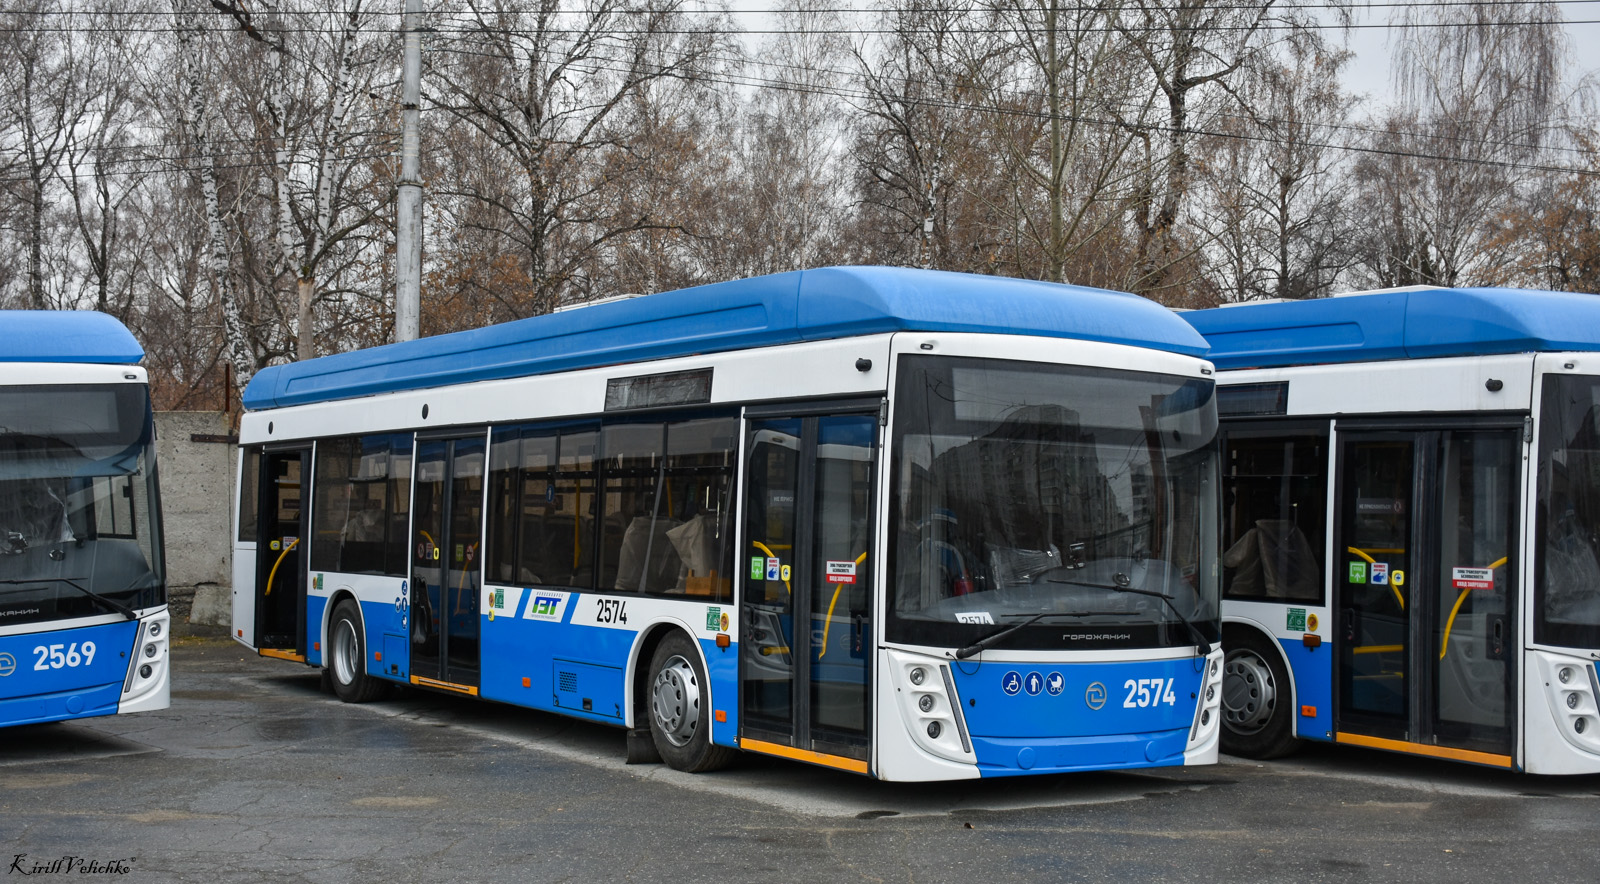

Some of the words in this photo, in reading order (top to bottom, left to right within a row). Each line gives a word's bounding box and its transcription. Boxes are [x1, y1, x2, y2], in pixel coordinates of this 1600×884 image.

[596, 598, 627, 625] 2574
[1063, 633, 1131, 641] ГОРОЖАНИН
[33, 641, 97, 671] 2569
[1123, 678, 1176, 709] 2574
